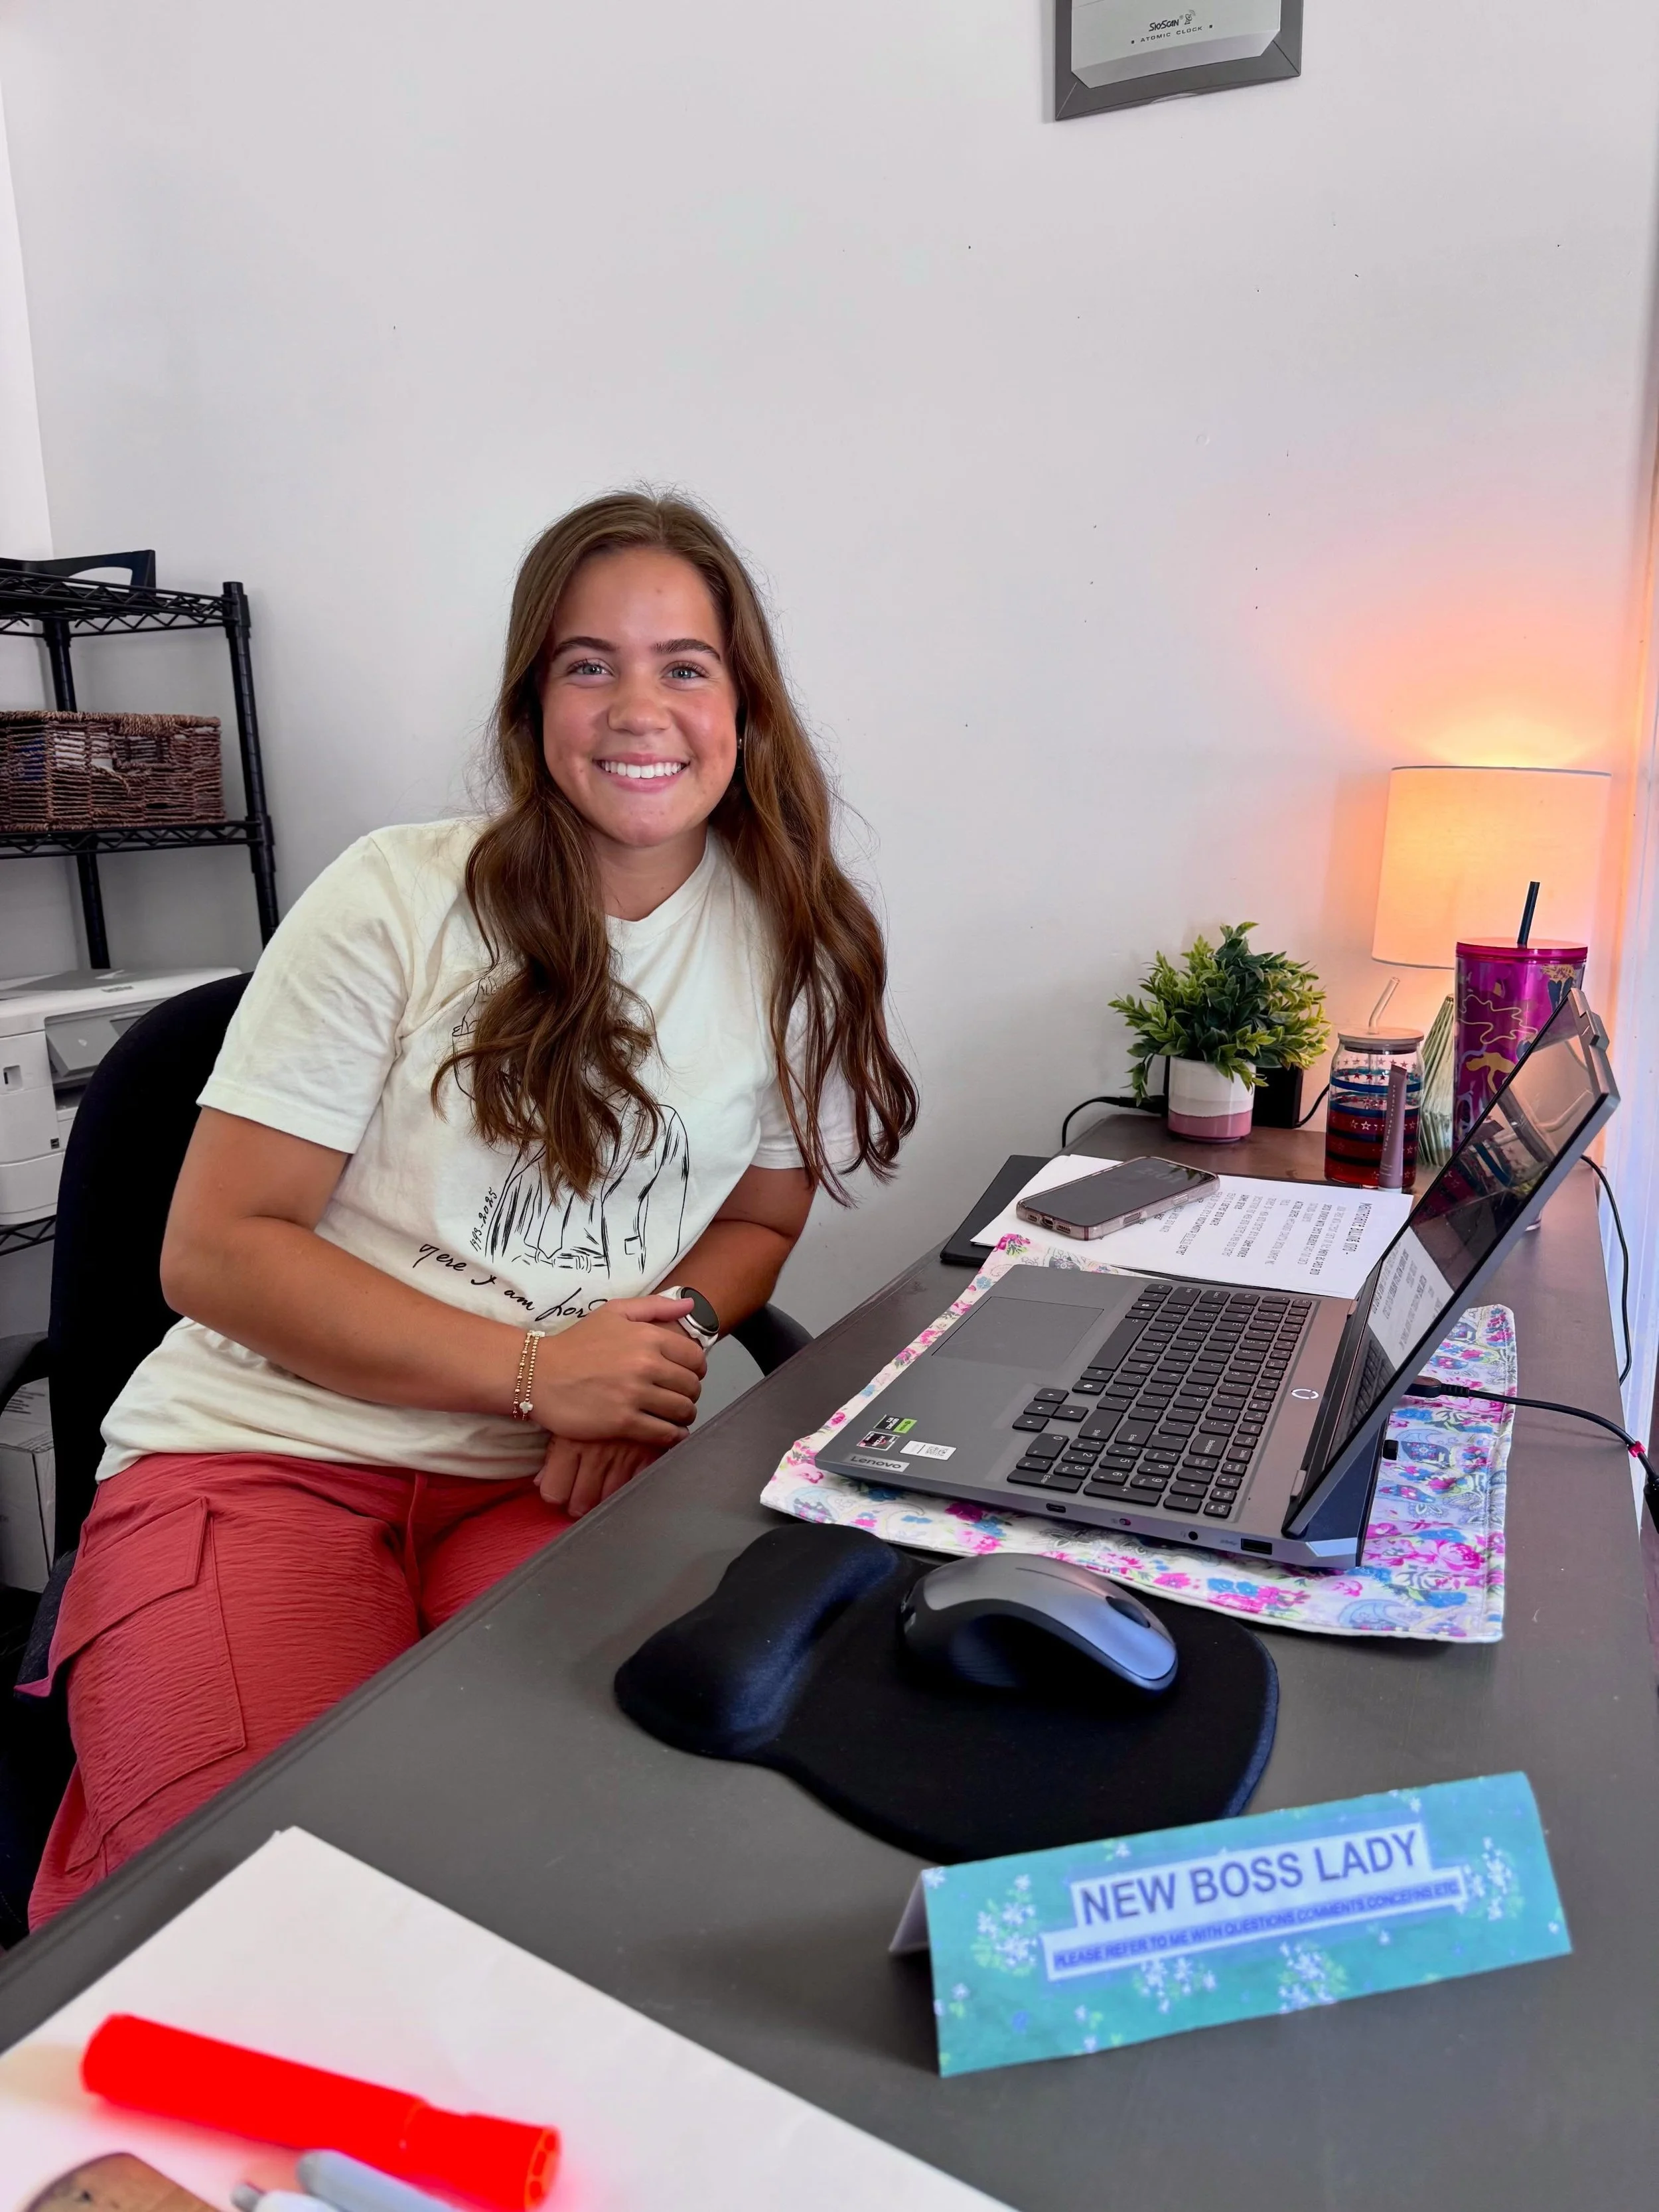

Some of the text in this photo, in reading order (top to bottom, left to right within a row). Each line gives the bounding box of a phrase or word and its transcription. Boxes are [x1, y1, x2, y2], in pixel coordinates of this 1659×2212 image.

[1140, 26, 1203, 42] ATOMIC CLOCK
[504, 1290, 535, 1311] am
[850, 1455, 901, 1469] Lenovo
[1080, 1829, 1416, 1925] NEW BOSS LADY
[1151, 1935, 1167, 1950] TO
[1169, 1931, 1188, 1946] ME
[1192, 1925, 1222, 1941] WITH
[1297, 1897, 1364, 1921] COMMENTS
